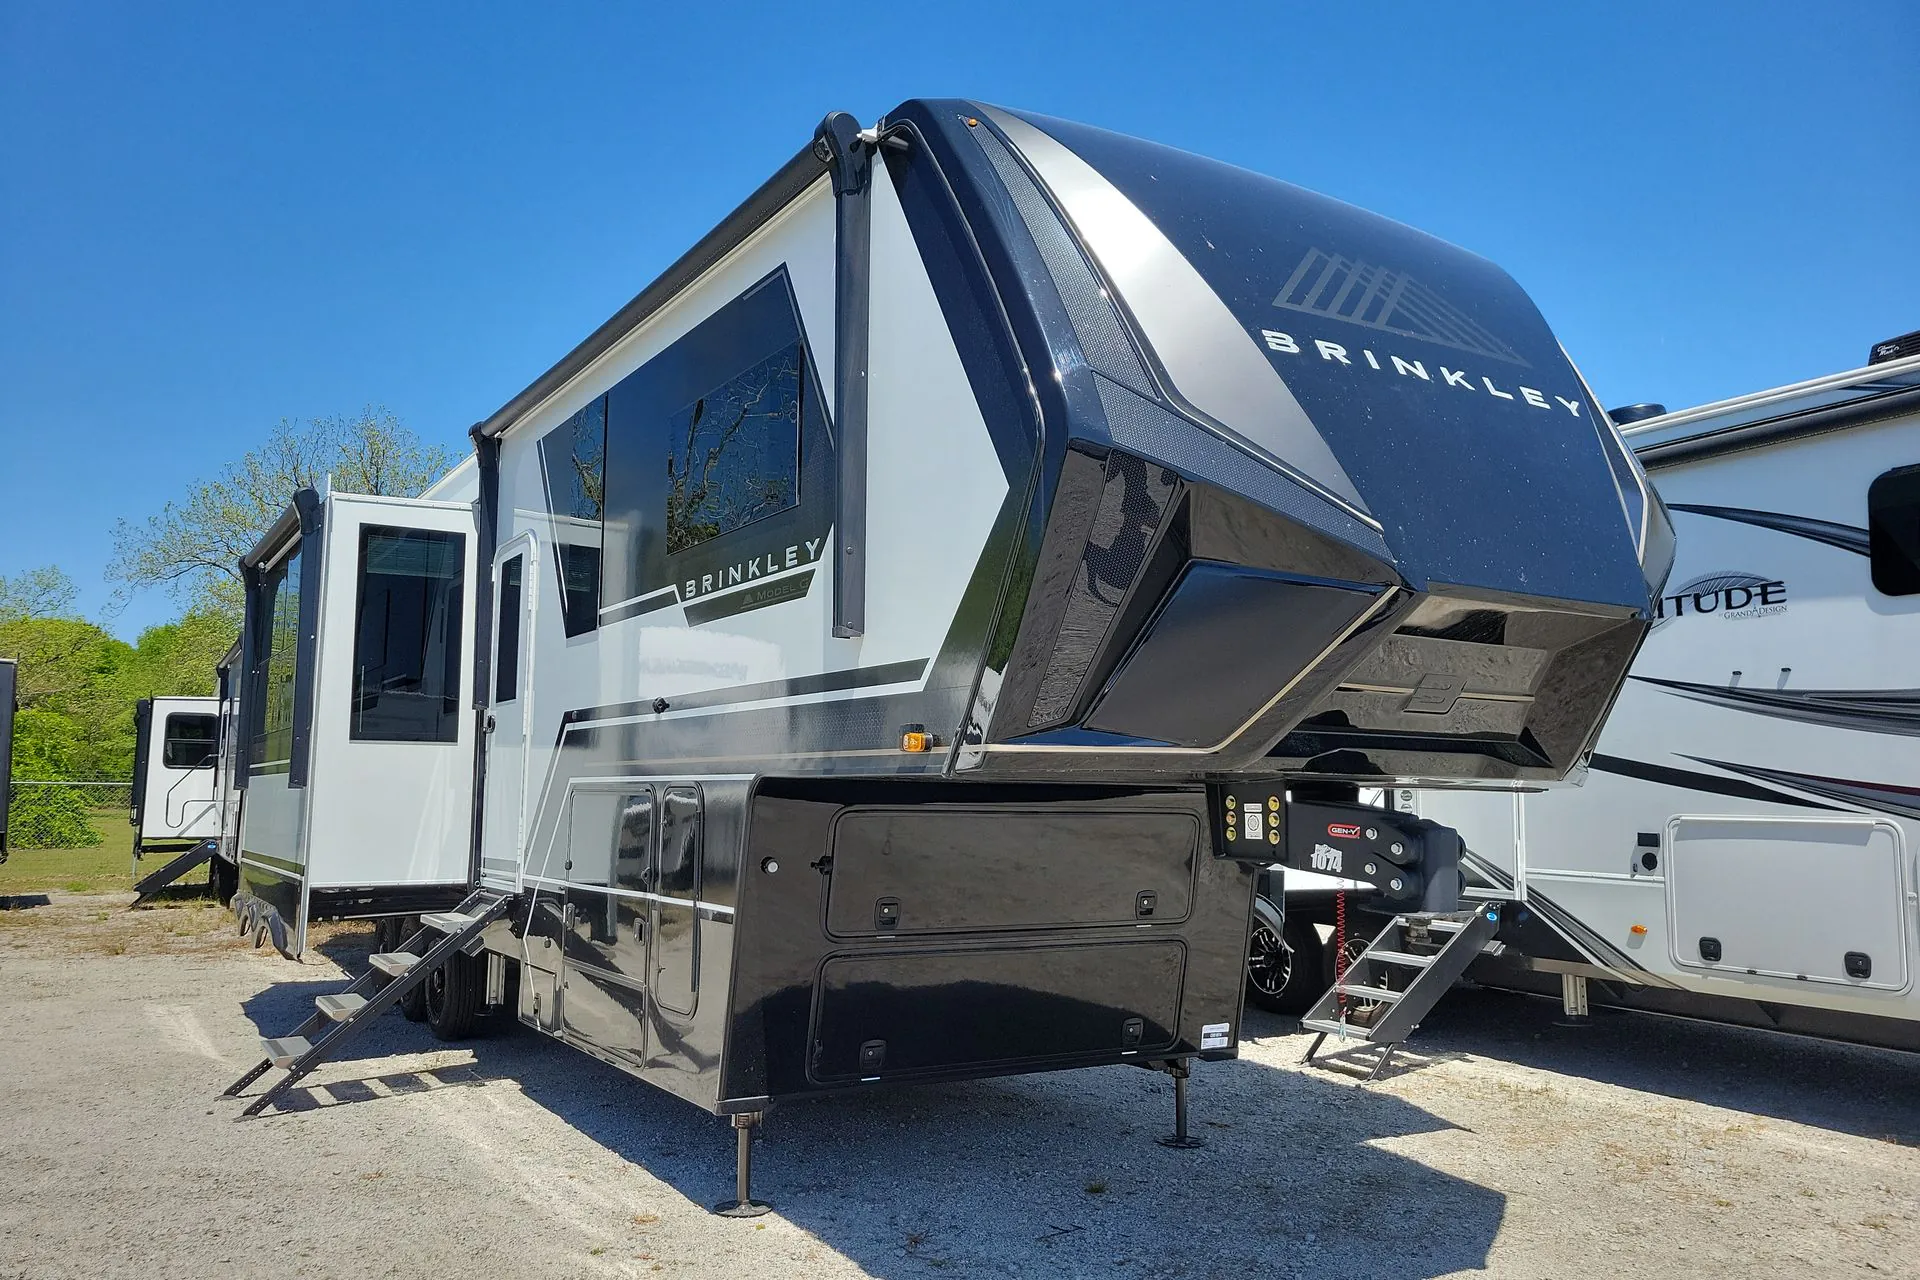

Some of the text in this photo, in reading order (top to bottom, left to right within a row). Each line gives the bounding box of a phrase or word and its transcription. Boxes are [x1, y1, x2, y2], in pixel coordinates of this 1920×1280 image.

[1261, 328, 1581, 418] BRINKLEY
[685, 537, 821, 599] BRINKLEY
[757, 585, 796, 600] MODEL
[1653, 580, 1788, 619] ITUDE
[1724, 609, 1754, 619] GRAND
[1758, 605, 1788, 616] DESIGN
[1331, 826, 1360, 835] GEN-Y
[1310, 852, 1342, 872] 1074
